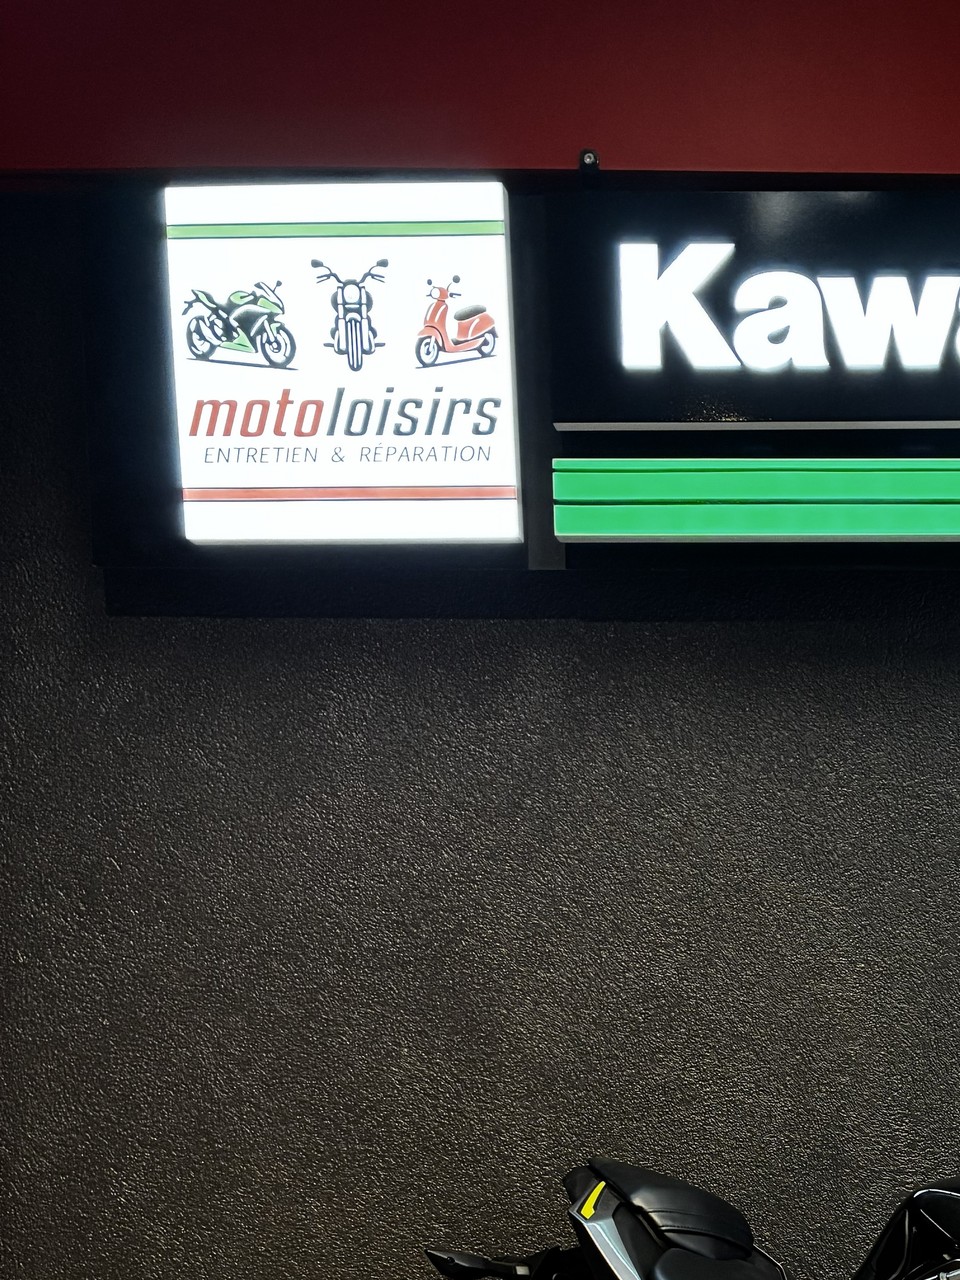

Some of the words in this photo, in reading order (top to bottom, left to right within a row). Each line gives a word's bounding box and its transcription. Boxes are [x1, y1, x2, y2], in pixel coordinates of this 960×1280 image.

[188, 386, 502, 438] motoloisirs
[203, 446, 319, 464] ENTRETIEN
[330, 446, 346, 463] &
[359, 443, 492, 463] RÉPARATION
